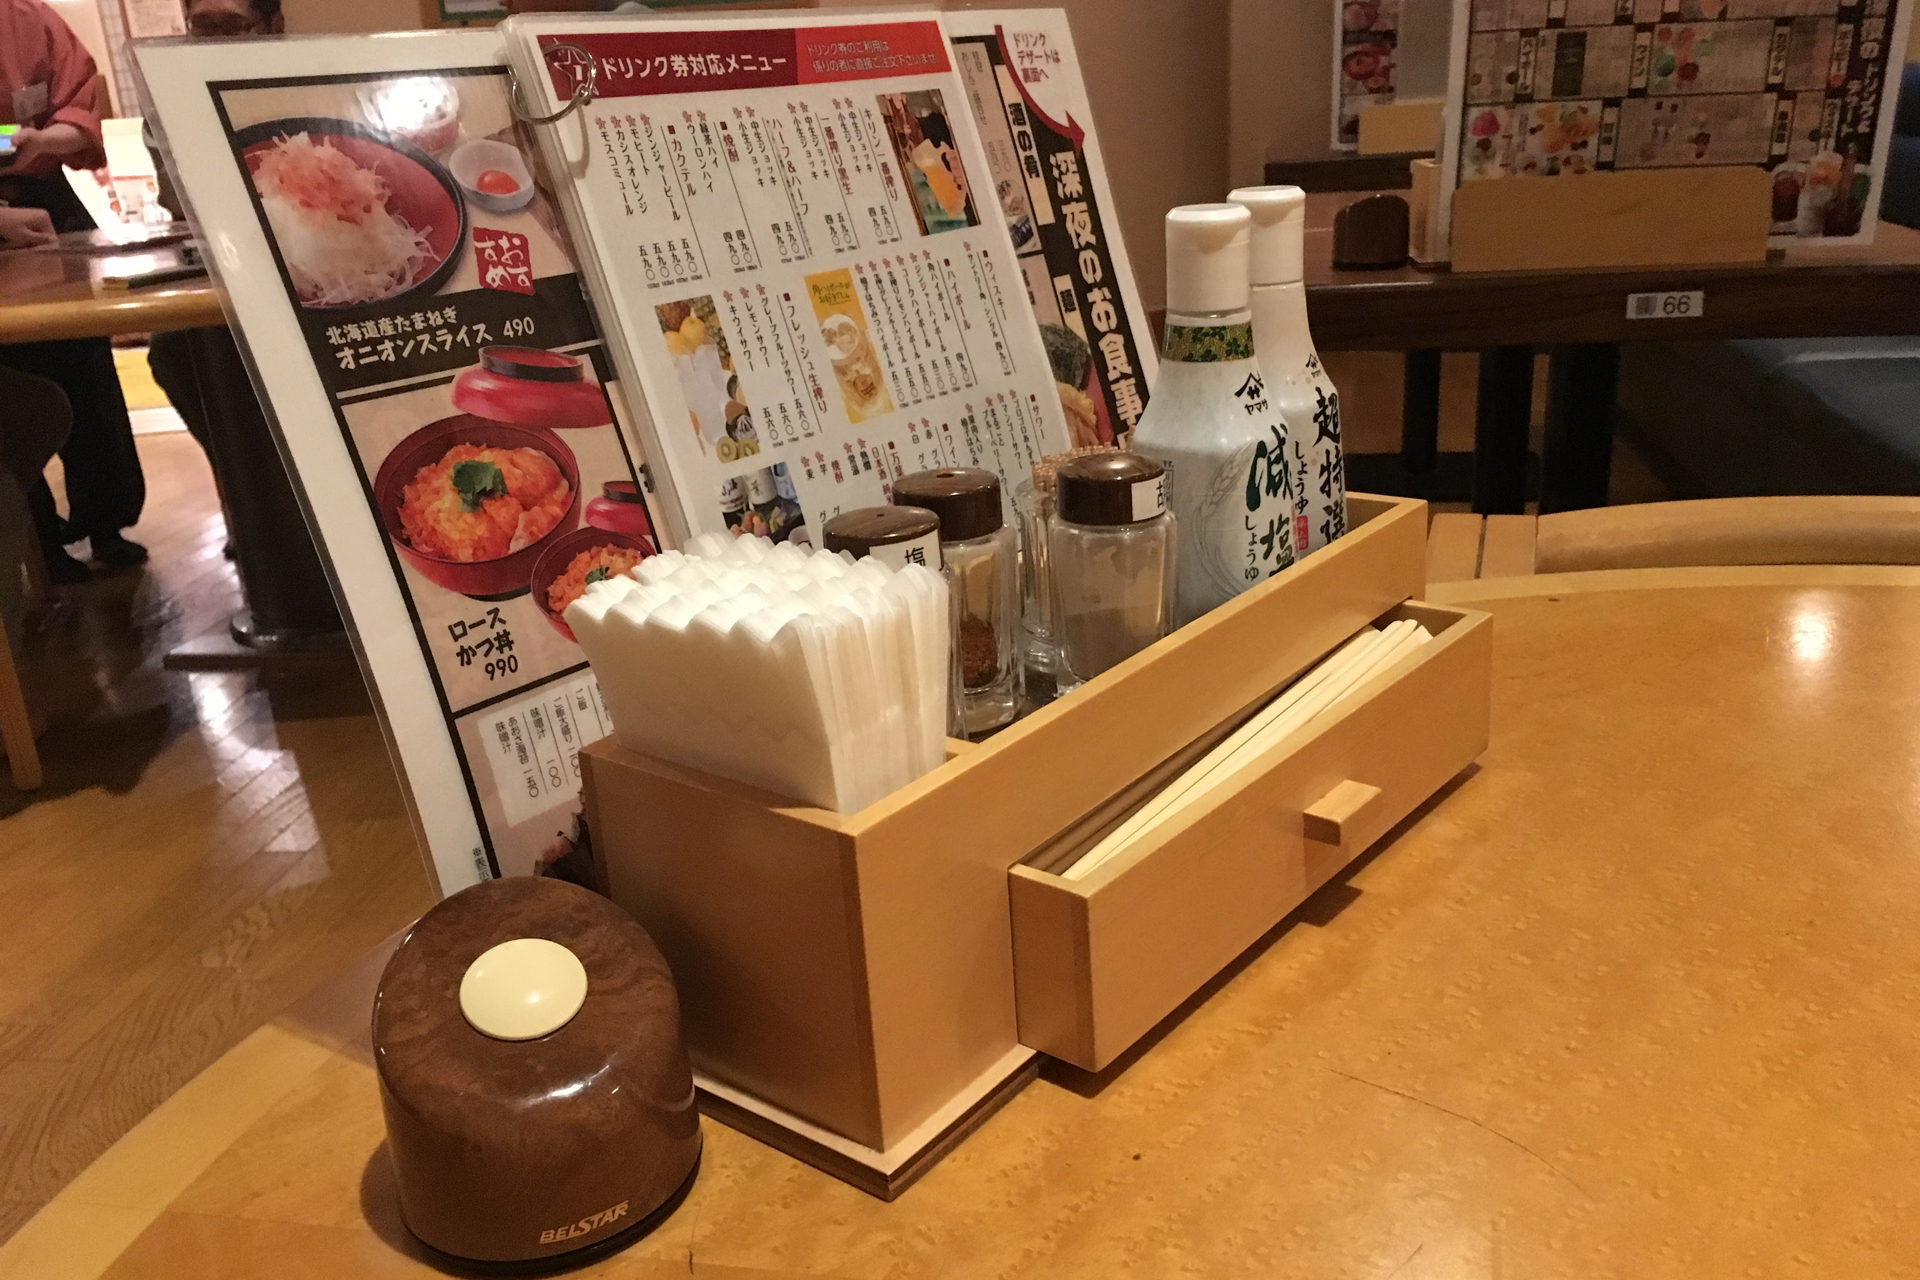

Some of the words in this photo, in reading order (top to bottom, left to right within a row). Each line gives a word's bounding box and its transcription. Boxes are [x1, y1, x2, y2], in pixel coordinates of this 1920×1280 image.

[602, 53, 787, 80] ドリンク券対応メニュー
[1013, 33, 1046, 48] ドリンク
[1017, 49, 1061, 64] デザートは
[1021, 67, 1049, 83] 裏面へ
[631, 129, 650, 176] モヒート
[671, 138, 697, 197] カクテル
[686, 124, 714, 193] ウーロンハイ
[699, 123, 718, 168] 緑茶ハイ
[722, 133, 740, 163] 焼酎
[738, 122, 765, 187] 小生ジョッキ
[750, 121, 778, 186] 中生ジョッキ
[771, 118, 809, 216] ハーフ&ハーフ
[793, 117, 818, 179] 小生ジョッキ
[804, 115, 829, 178] 中生ジョッキ
[820, 117, 854, 196] 一番搾り黒生
[838, 112, 862, 173] 小生ジョッキ
[848, 111, 873, 172] 中生ジョッキ
[864, 108, 898, 201] キリン一番搾り
[600, 131, 634, 216] モスコミュール
[616, 130, 648, 214] カシスオレンジ
[644, 127, 681, 222] ジンジャービール
[901, 268, 932, 349] コークハイボール
[914, 265, 947, 352] ジンジャーハイボール
[927, 262, 950, 322] 角ハイボール
[947, 271, 971, 331] ハイボール
[985, 260, 1007, 321] ウィスキー
[1663, 295, 1690, 315] 66
[326, 305, 457, 346] 北海道産たまねぎ
[335, 322, 493, 370] オニオンスライス
[503, 316, 535, 338] 490
[729, 305, 754, 371] キウイサワー
[745, 302, 770, 367] レモンサワー
[761, 297, 796, 395] グレープフルーツサワー
[786, 305, 827, 413] フレッシュ生搾り
[1032, 405, 1045, 440] サワー
[1244, 398, 1268, 415] ヤマサ
[871, 447, 887, 480] 日本酒
[961, 417, 979, 468] 柚子はちみ
[1246, 423, 1294, 577] 減塩
[1295, 440, 1309, 515] しょうゆ
[1244, 515, 1259, 581] しょうゆ
[448, 607, 507, 642] ロース
[456, 629, 515, 667] かつ丼
[484, 654, 519, 681] 990
[495, 721, 511, 754] 味噌汁
[530, 707, 546, 740] 味噌汁
[540, 1200, 629, 1244] BELSTAR
